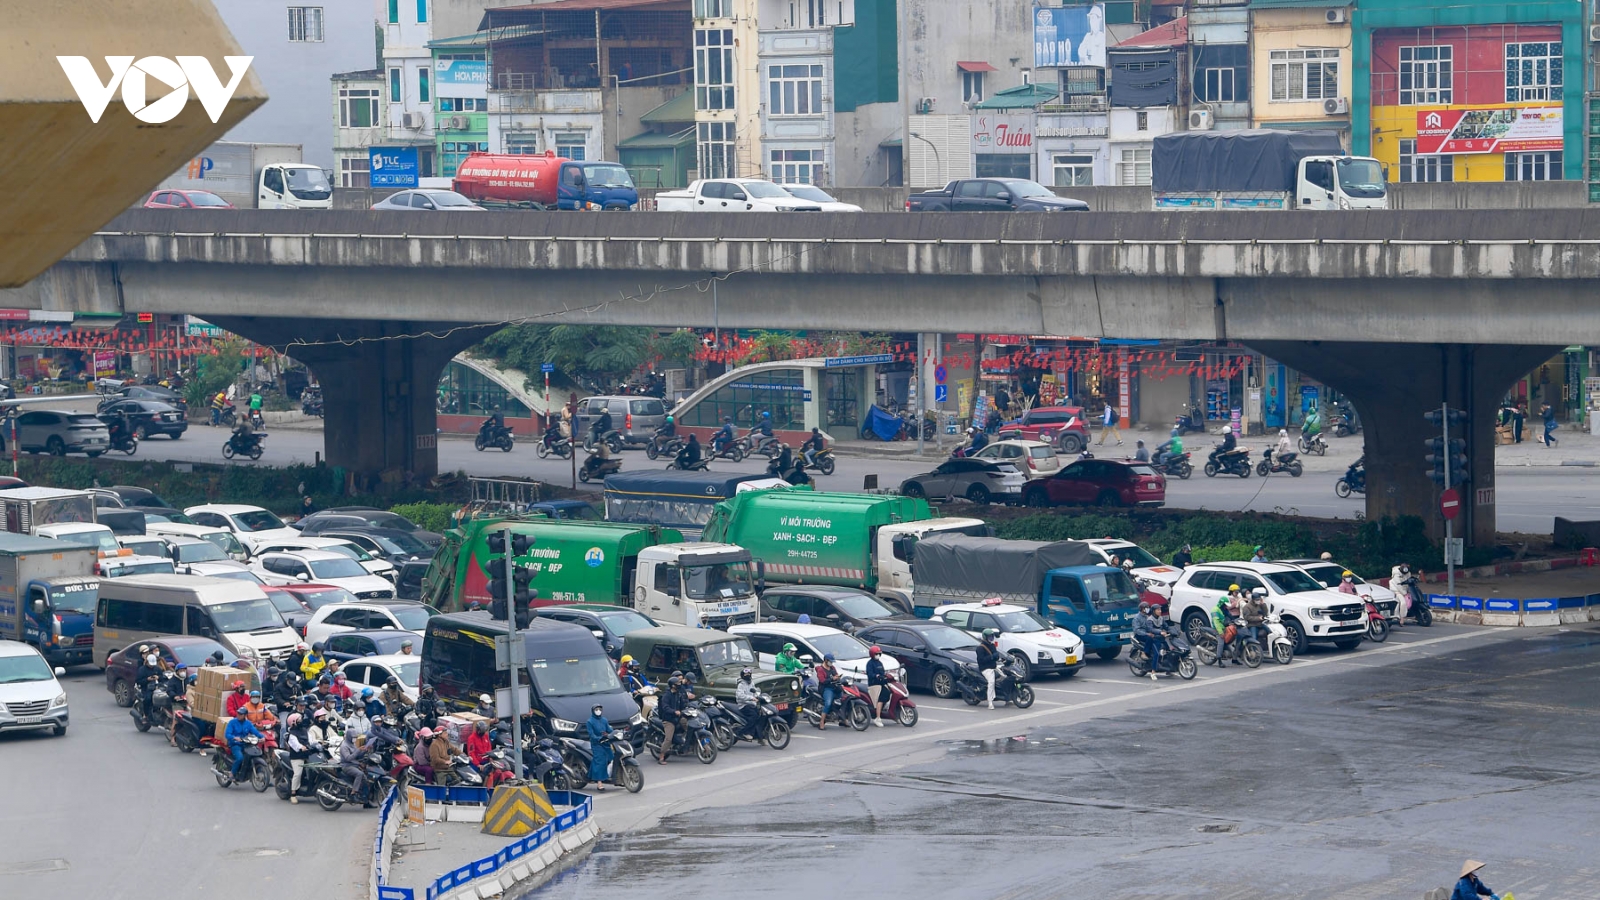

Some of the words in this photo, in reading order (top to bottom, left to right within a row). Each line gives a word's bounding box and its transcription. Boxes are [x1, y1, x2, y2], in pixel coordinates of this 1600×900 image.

[995, 123, 1032, 147] Tuấn
[383, 156, 399, 165] TLC
[508, 168, 517, 178] SỐ
[520, 169, 528, 178] HÀ
[780, 516, 788, 526] VÌ
[788, 516, 802, 527] MÔI
[802, 517, 832, 528] TRƯỜNG
[773, 532, 792, 541] XANH
[822, 535, 838, 546] ĐẸP
[531, 547, 560, 559] TRƯỜNG
[548, 563, 563, 574] ĐẸP
[64, 584, 84, 592] ĐỨC
